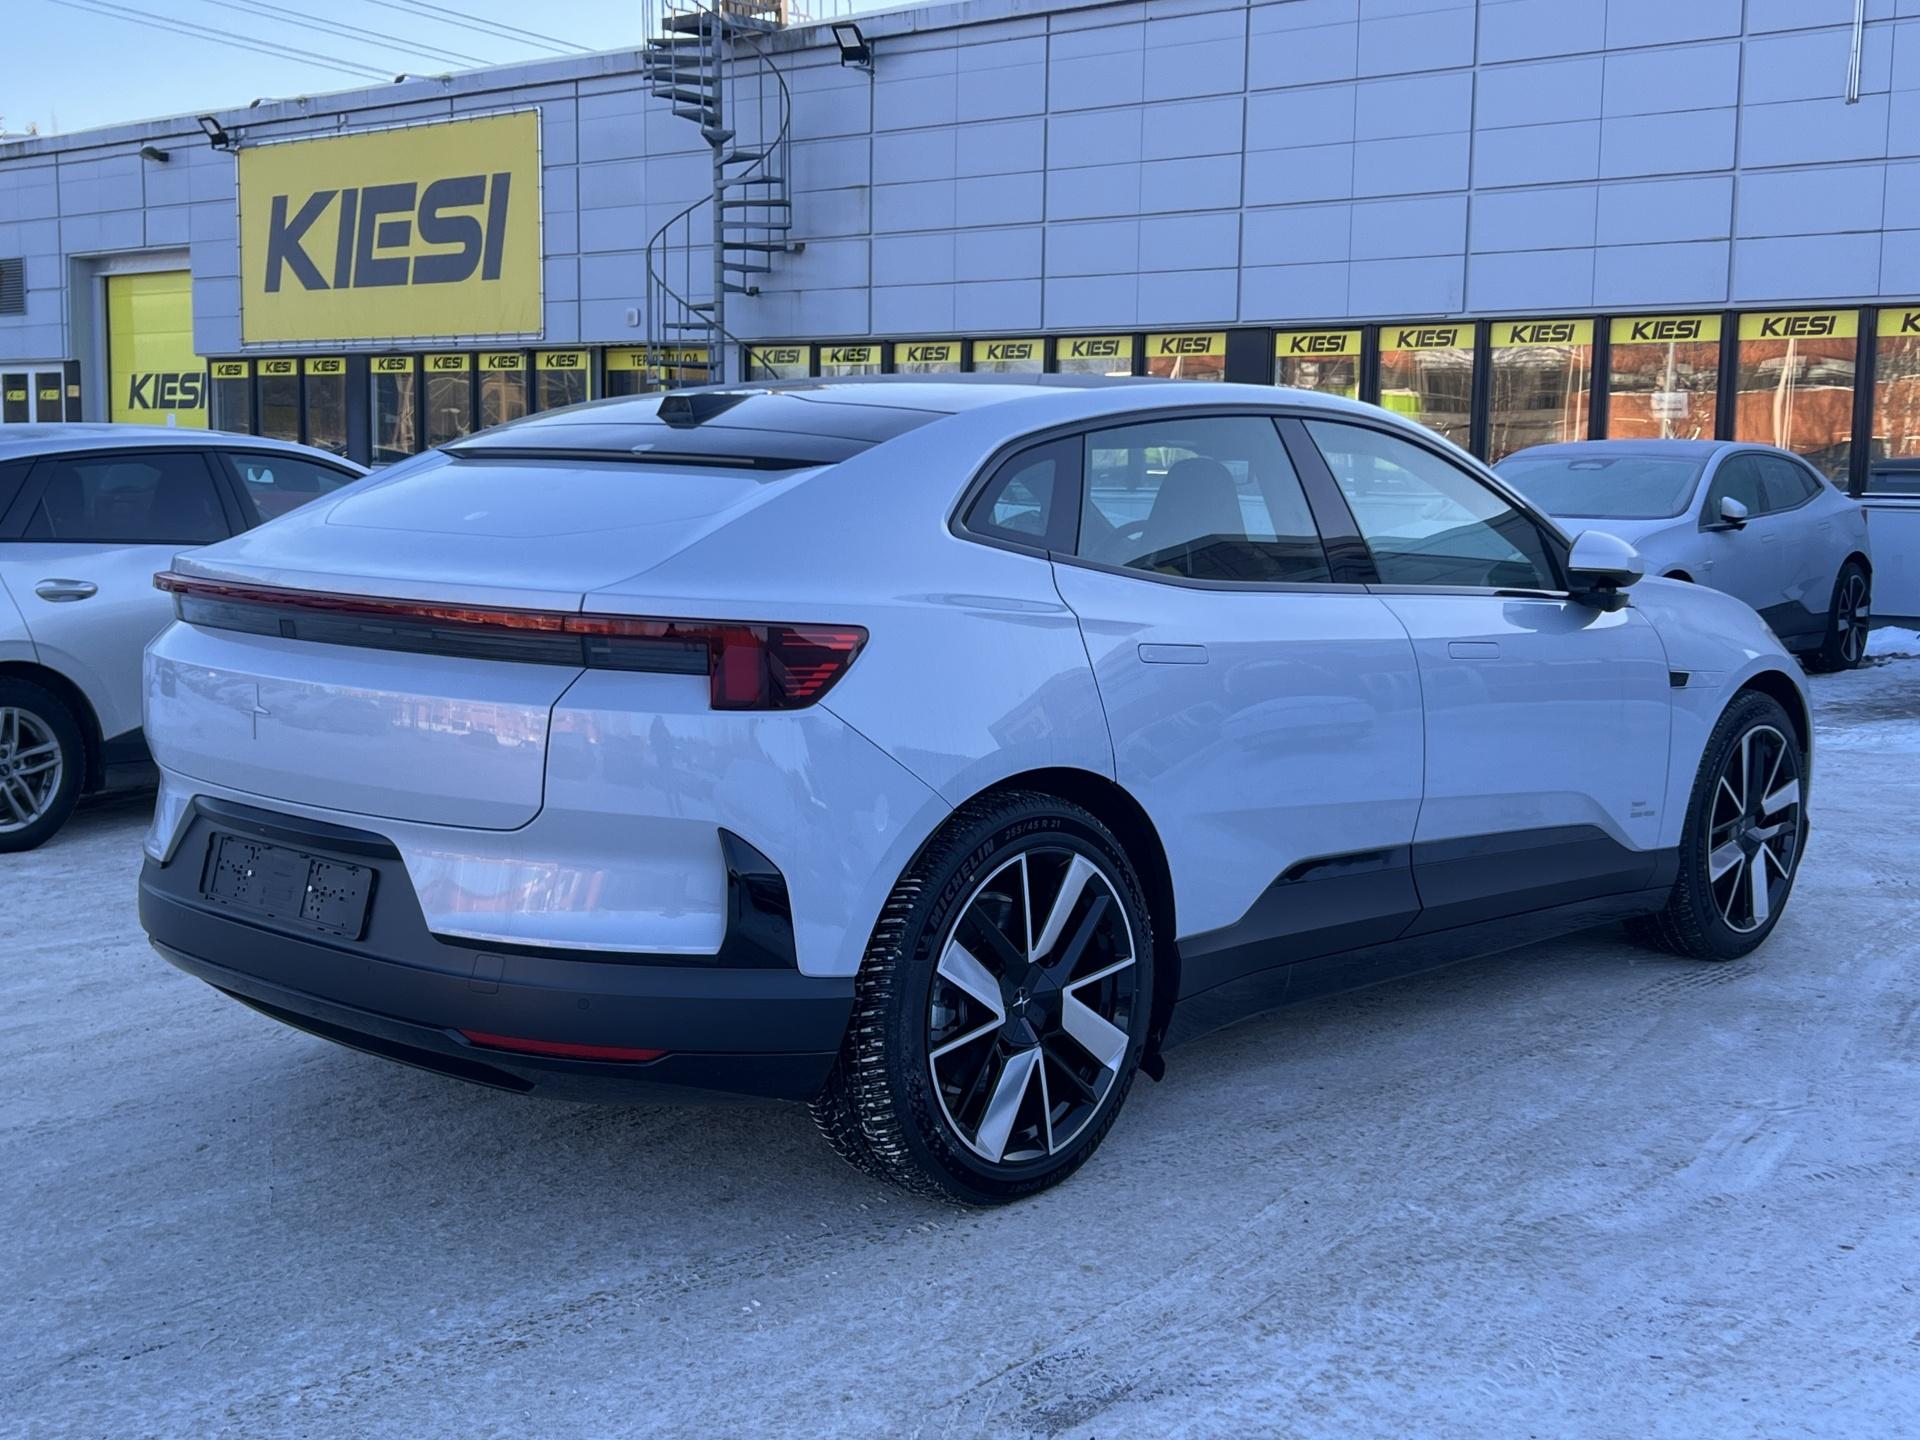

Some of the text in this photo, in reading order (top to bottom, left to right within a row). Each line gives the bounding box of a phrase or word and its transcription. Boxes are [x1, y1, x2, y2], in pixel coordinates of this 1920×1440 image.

[264, 172, 511, 293] KIESI
[1510, 323, 1575, 343] KIESI
[1631, 319, 1702, 341] KIESI
[1760, 315, 1837, 337] KIESI
[1160, 336, 1212, 354] KIESI
[1290, 335, 1347, 353] KIESI
[1397, 329, 1458, 348] KIESI
[762, 349, 800, 364] KIESI
[830, 347, 871, 363] KIESI
[907, 346, 950, 361] KIESI
[987, 343, 1033, 360] KIESI
[1071, 340, 1120, 357] KIESI
[265, 361, 291, 374] KIESI
[313, 360, 340, 373] KIESI
[377, 358, 407, 370] KIESI
[433, 356, 463, 370] KIESI
[488, 355, 520, 369] KIESI
[545, 353, 579, 368] KIESI
[218, 364, 242, 376] KIESI
[128, 373, 207, 410] KIESI
[929, 819, 1061, 929] MICHELIN 255/45 R 21
